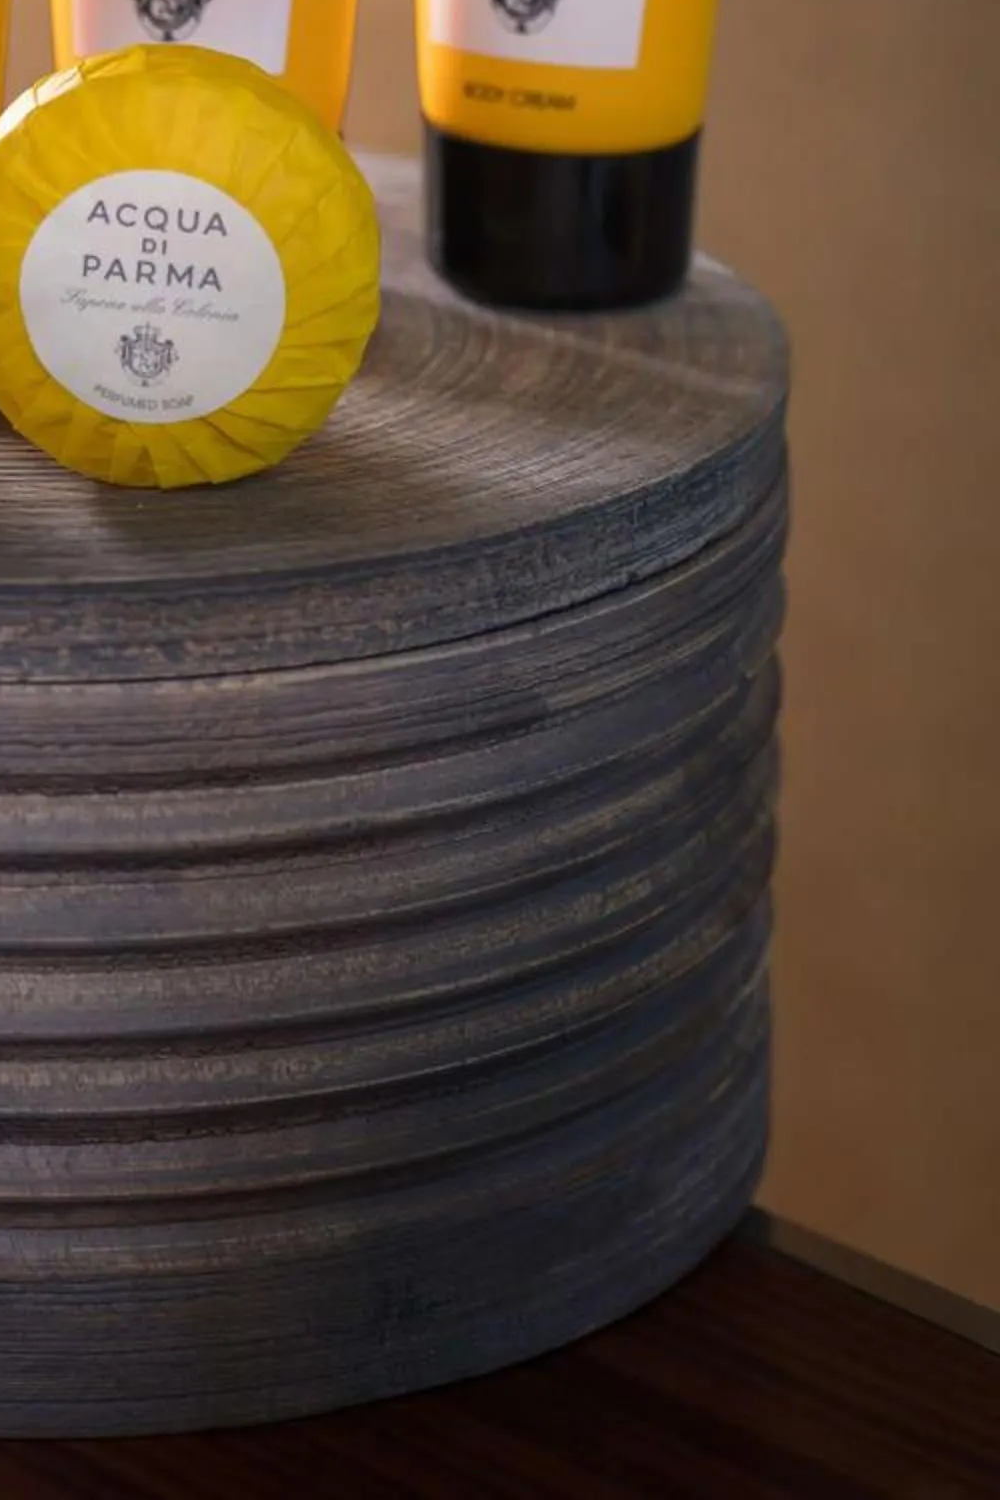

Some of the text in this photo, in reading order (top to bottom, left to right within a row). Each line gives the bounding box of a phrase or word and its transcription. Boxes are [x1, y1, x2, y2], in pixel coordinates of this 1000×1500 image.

[87, 200, 228, 236] ACQUA
[141, 238, 167, 255] DI
[83, 254, 222, 292] PARMA
